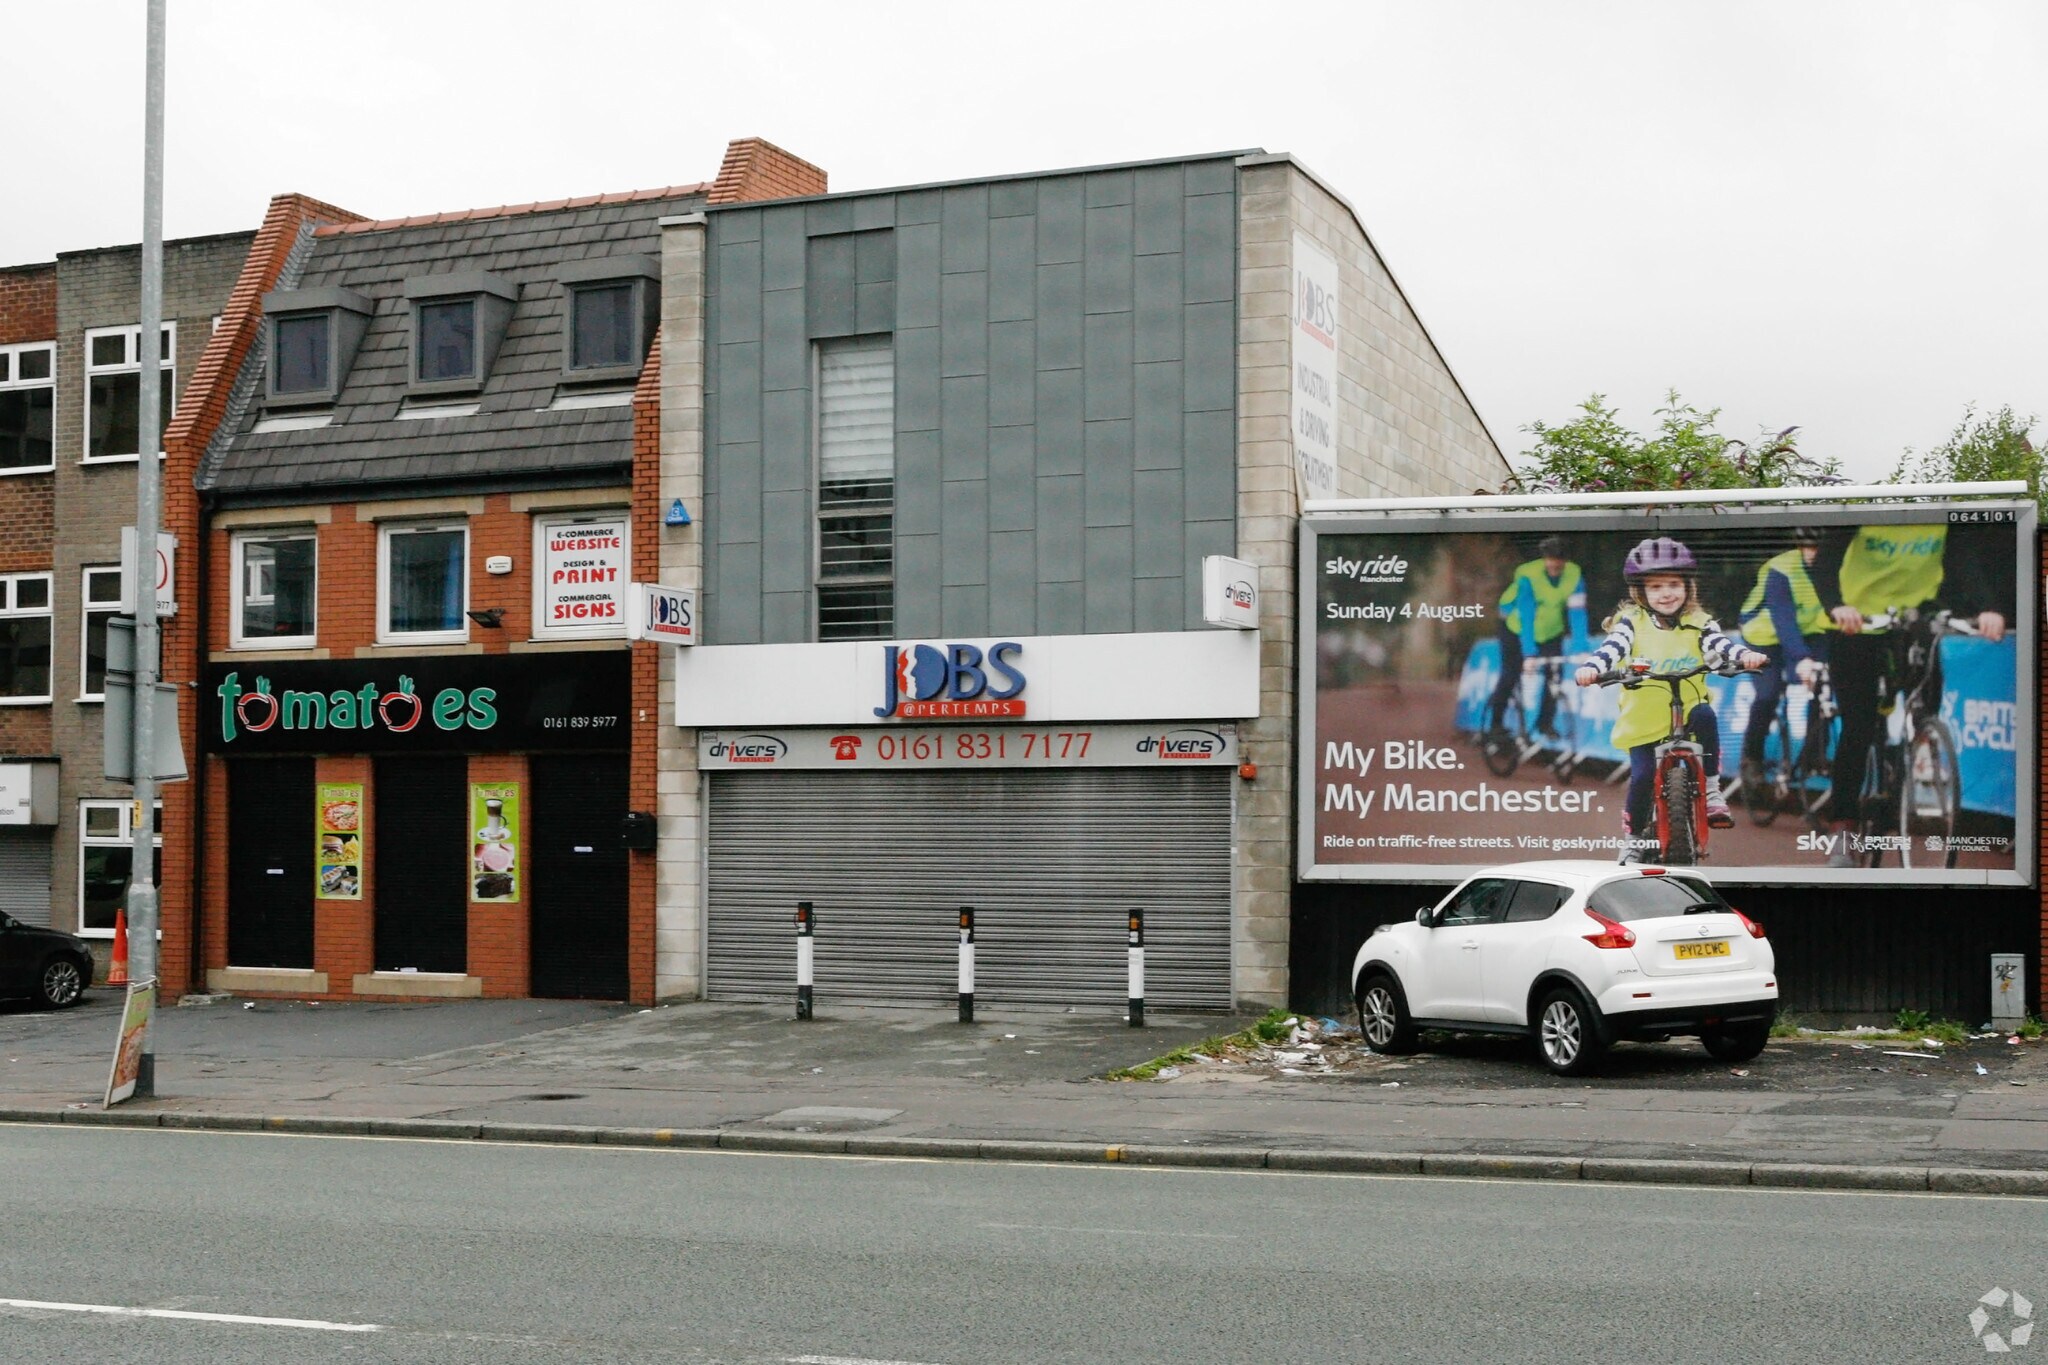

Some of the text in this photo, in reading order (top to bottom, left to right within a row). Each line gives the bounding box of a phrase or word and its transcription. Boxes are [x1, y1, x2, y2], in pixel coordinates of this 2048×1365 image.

[557, 529, 614, 538] E-COMMERCE
[551, 537, 620, 552] WEBSITE
[563, 560, 595, 568] DESIGN
[1325, 555, 1408, 578] sky ride
[553, 568, 617, 584] PRINT
[558, 594, 612, 602] COMMERCIAL
[554, 602, 616, 619] SIGNS
[647, 594, 690, 630] JOBS
[1326, 602, 1484, 623] Sunday 4 August
[873, 642, 1027, 717] JOBS
[217, 672, 498, 742] tomatoes
[903, 702, 1011, 716] @PERTEMPS
[543, 716, 617, 728] 0161 839 5977
[709, 741, 777, 762] drivers
[877, 732, 1092, 760] 0161 831 7177
[1136, 735, 1214, 758] drivers
[1323, 740, 1465, 777] My Bike.
[1323, 782, 1604, 819] My Manchester.
[1323, 835, 1660, 851] Ride on traffic-free streets. Visit goskyride.com
[1796, 830, 1838, 855] sky
[1945, 836, 2008, 846] MANCHESTER
